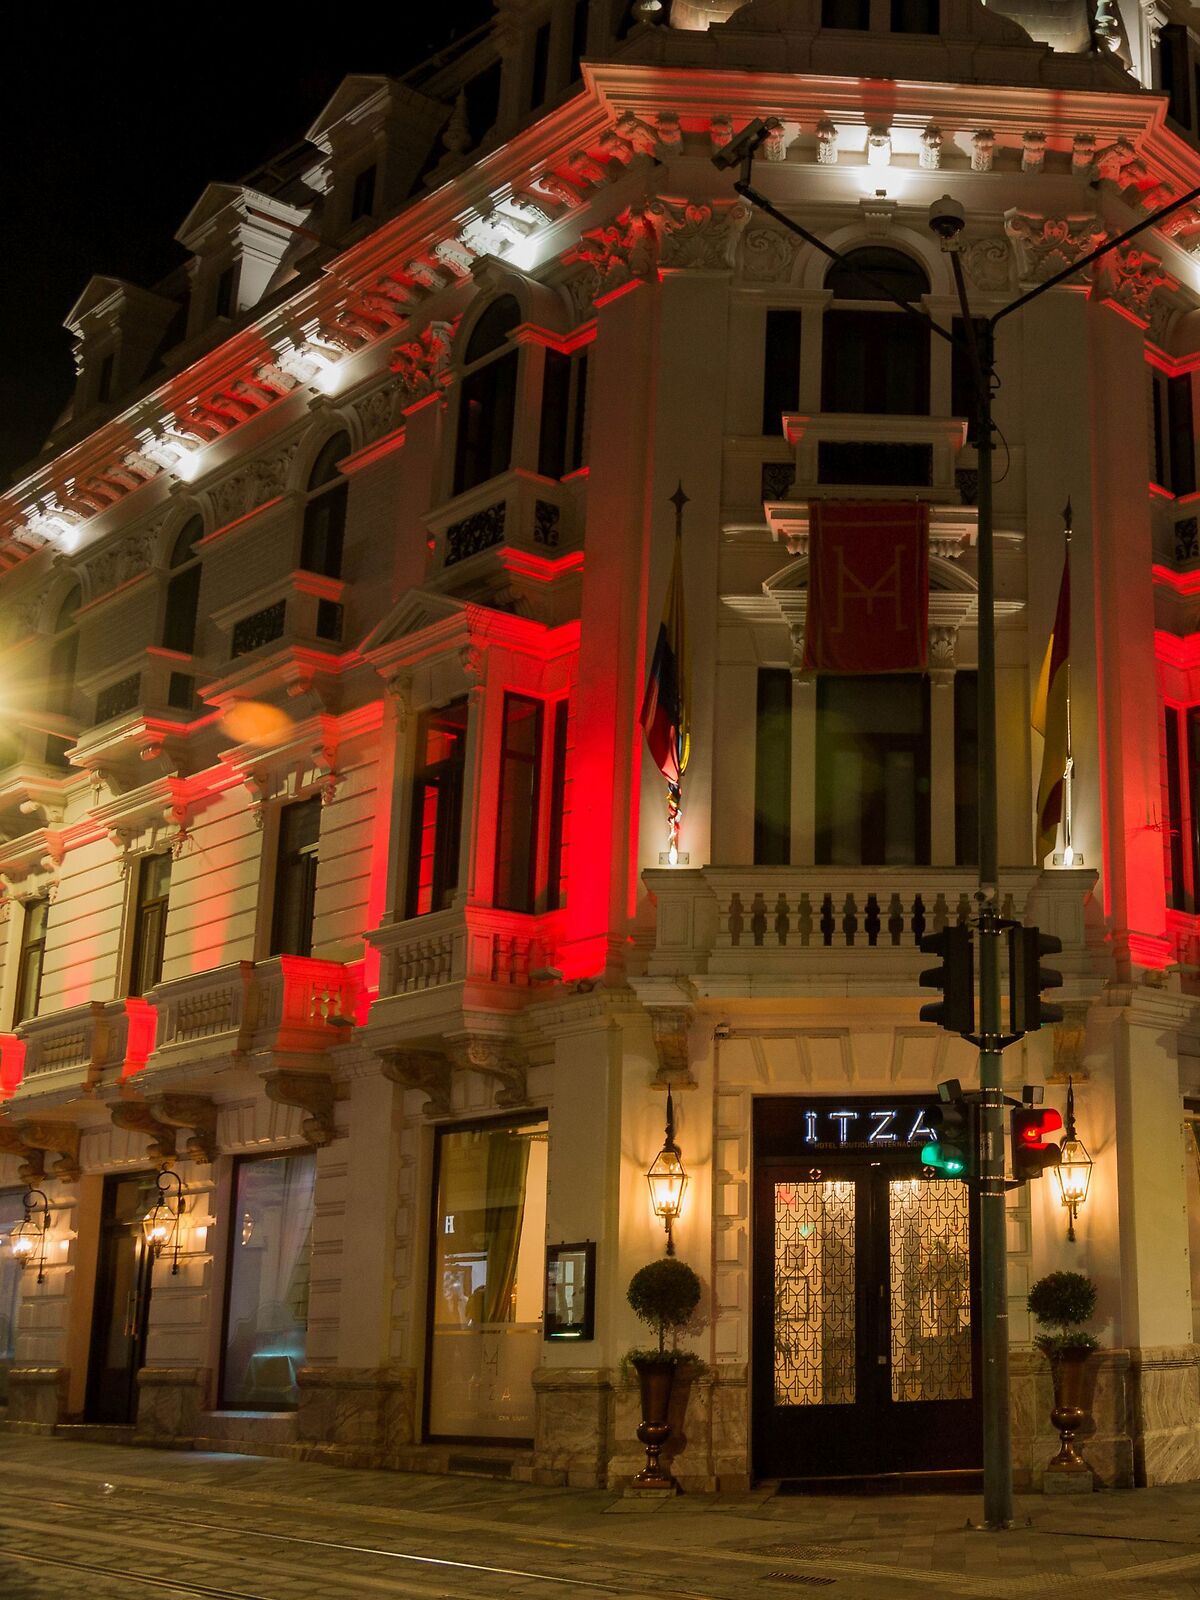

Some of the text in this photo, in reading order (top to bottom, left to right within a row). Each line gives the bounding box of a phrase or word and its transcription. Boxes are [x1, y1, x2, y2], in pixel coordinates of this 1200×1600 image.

[804, 1110, 938, 1143] ITZA
[815, 1140, 927, 1149] HOTEL BOUTIQUE INTERNACIONA
